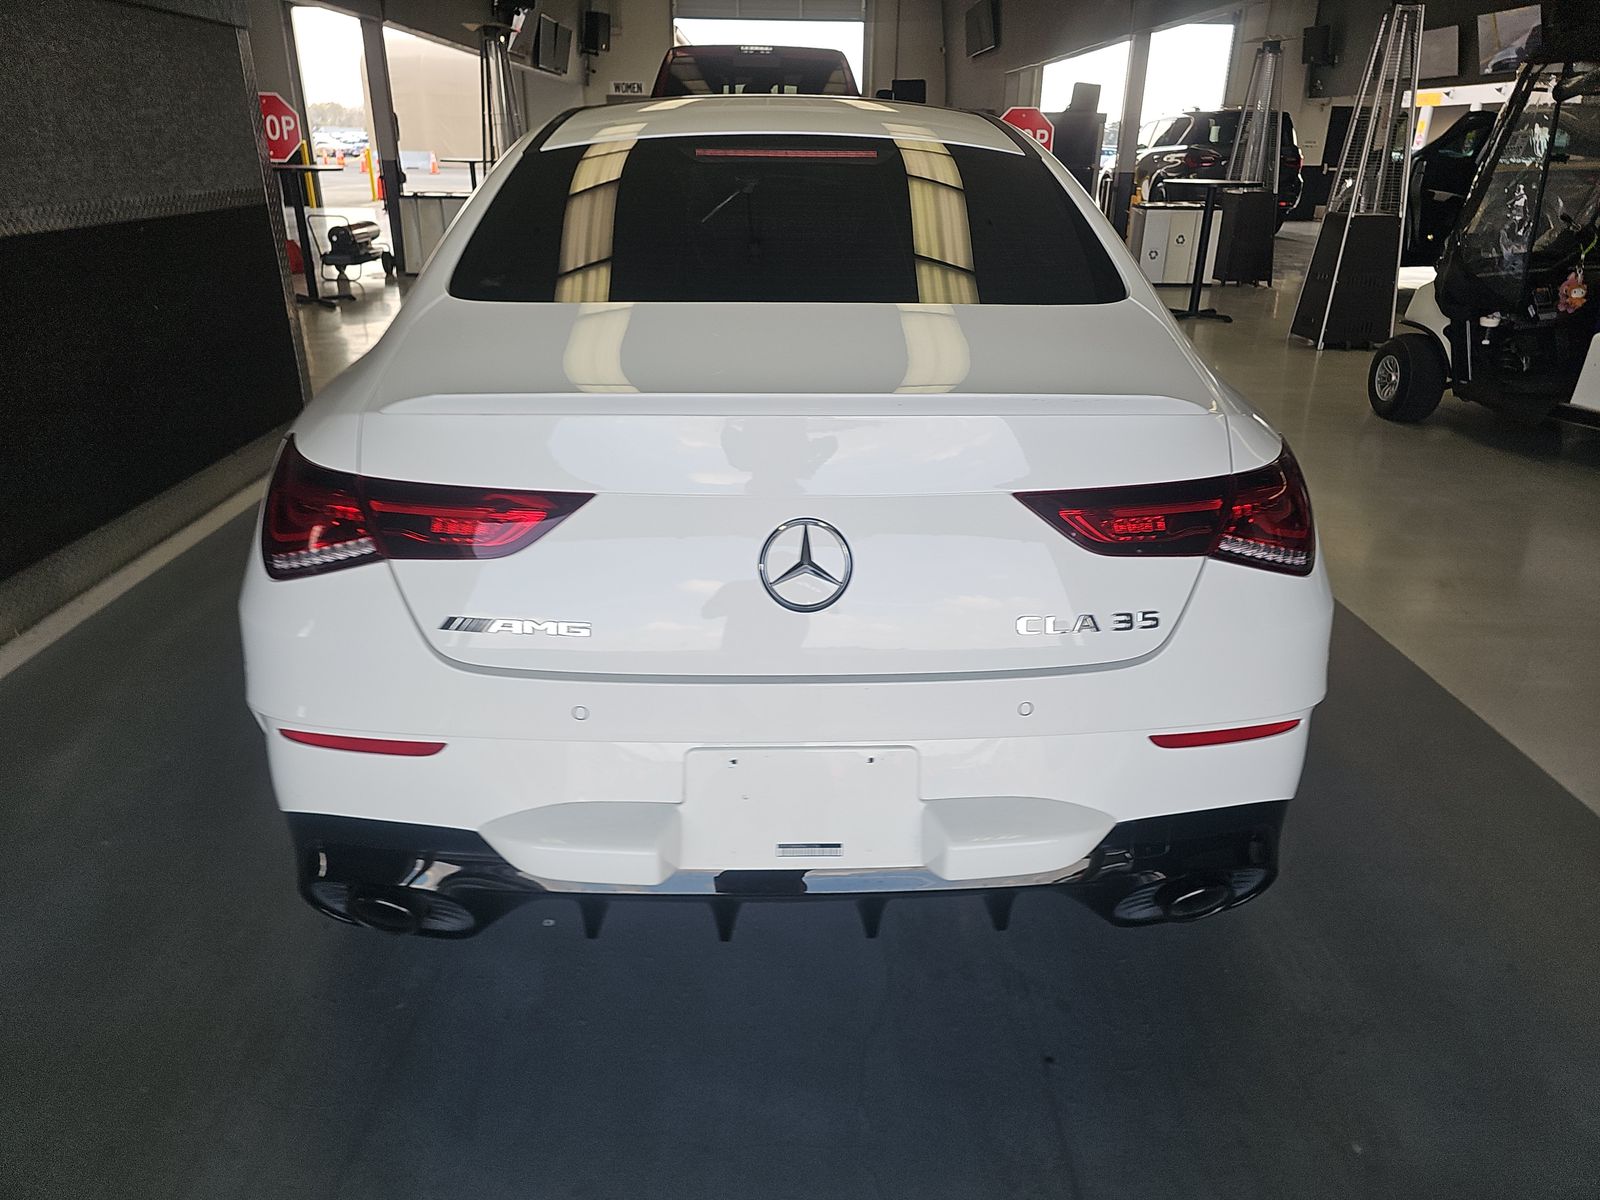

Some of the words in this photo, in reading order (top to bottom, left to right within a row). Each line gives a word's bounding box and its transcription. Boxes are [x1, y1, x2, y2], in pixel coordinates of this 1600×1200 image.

[613, 82, 643, 94] WOMEN
[264, 114, 295, 141] OP
[486, 618, 592, 638] AMG
[1015, 614, 1101, 636] CLA
[1111, 610, 1161, 632] 35
